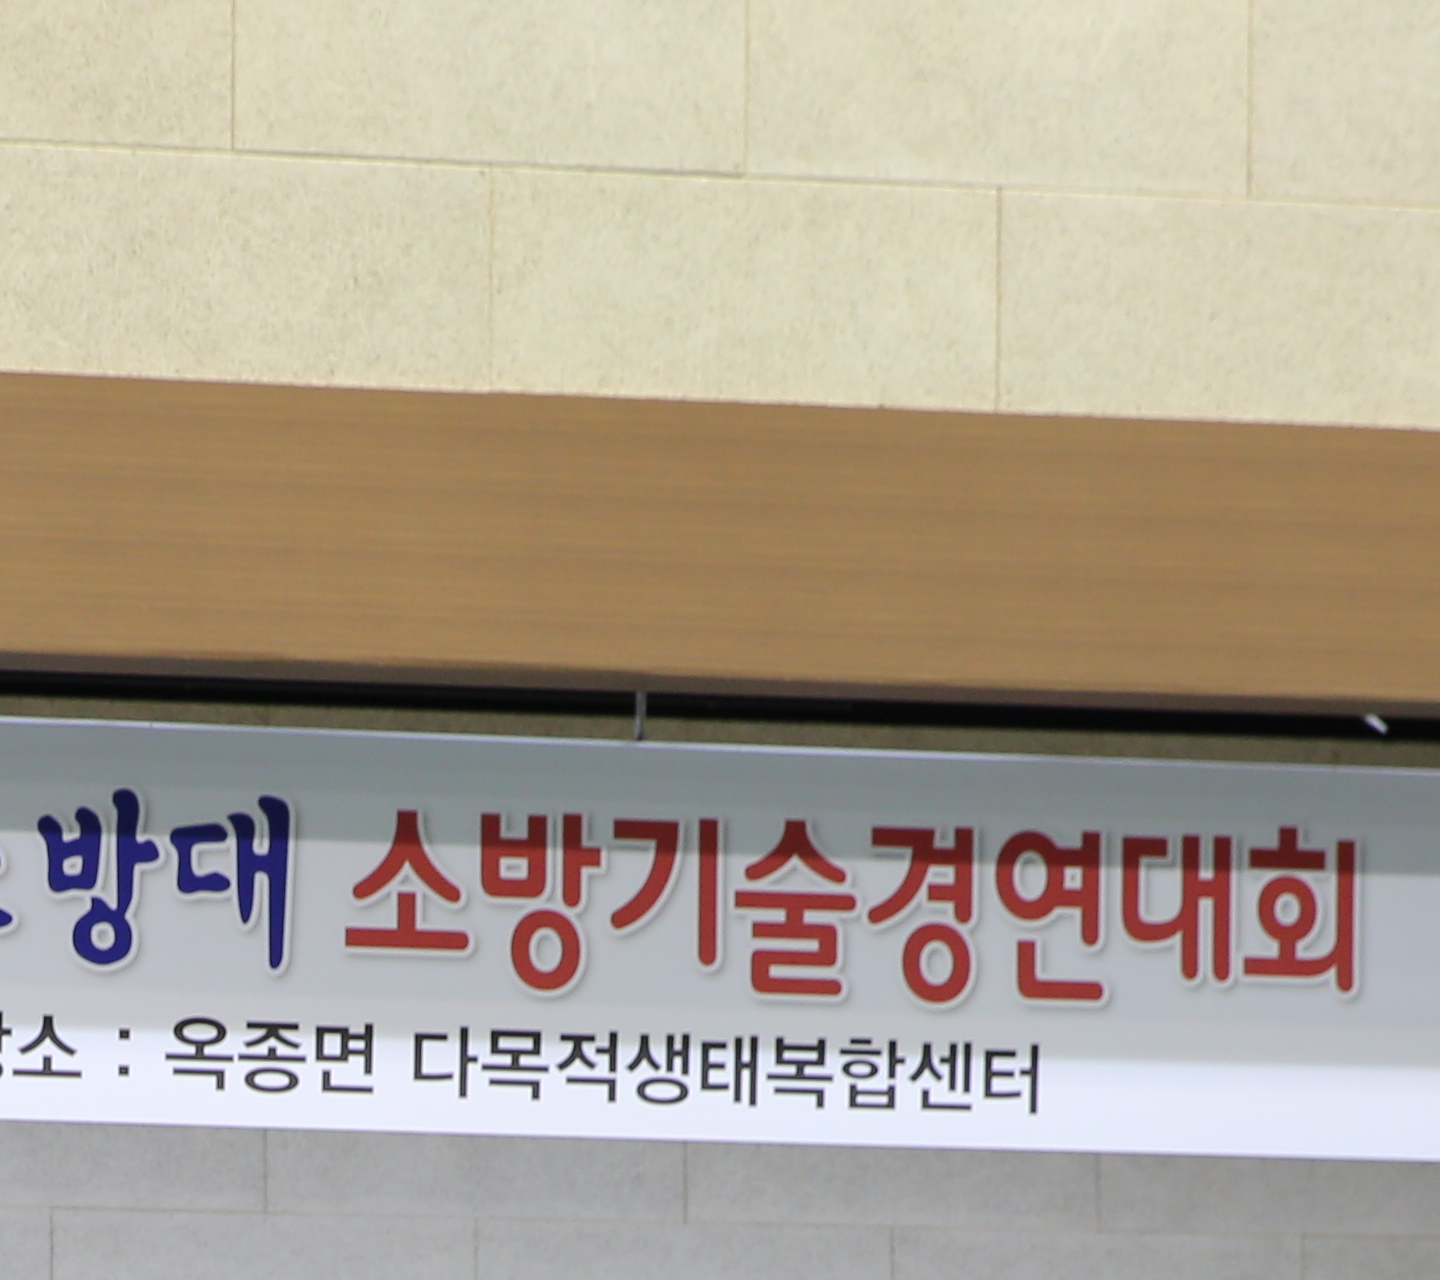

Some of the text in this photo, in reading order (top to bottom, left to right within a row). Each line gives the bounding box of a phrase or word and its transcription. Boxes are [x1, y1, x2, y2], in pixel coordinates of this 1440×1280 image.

[346, 810, 1355, 1002] 소방기술경연대회
[166, 1018, 373, 1092] 옥종면
[415, 1027, 1038, 1113] 다목적생태복합센터
